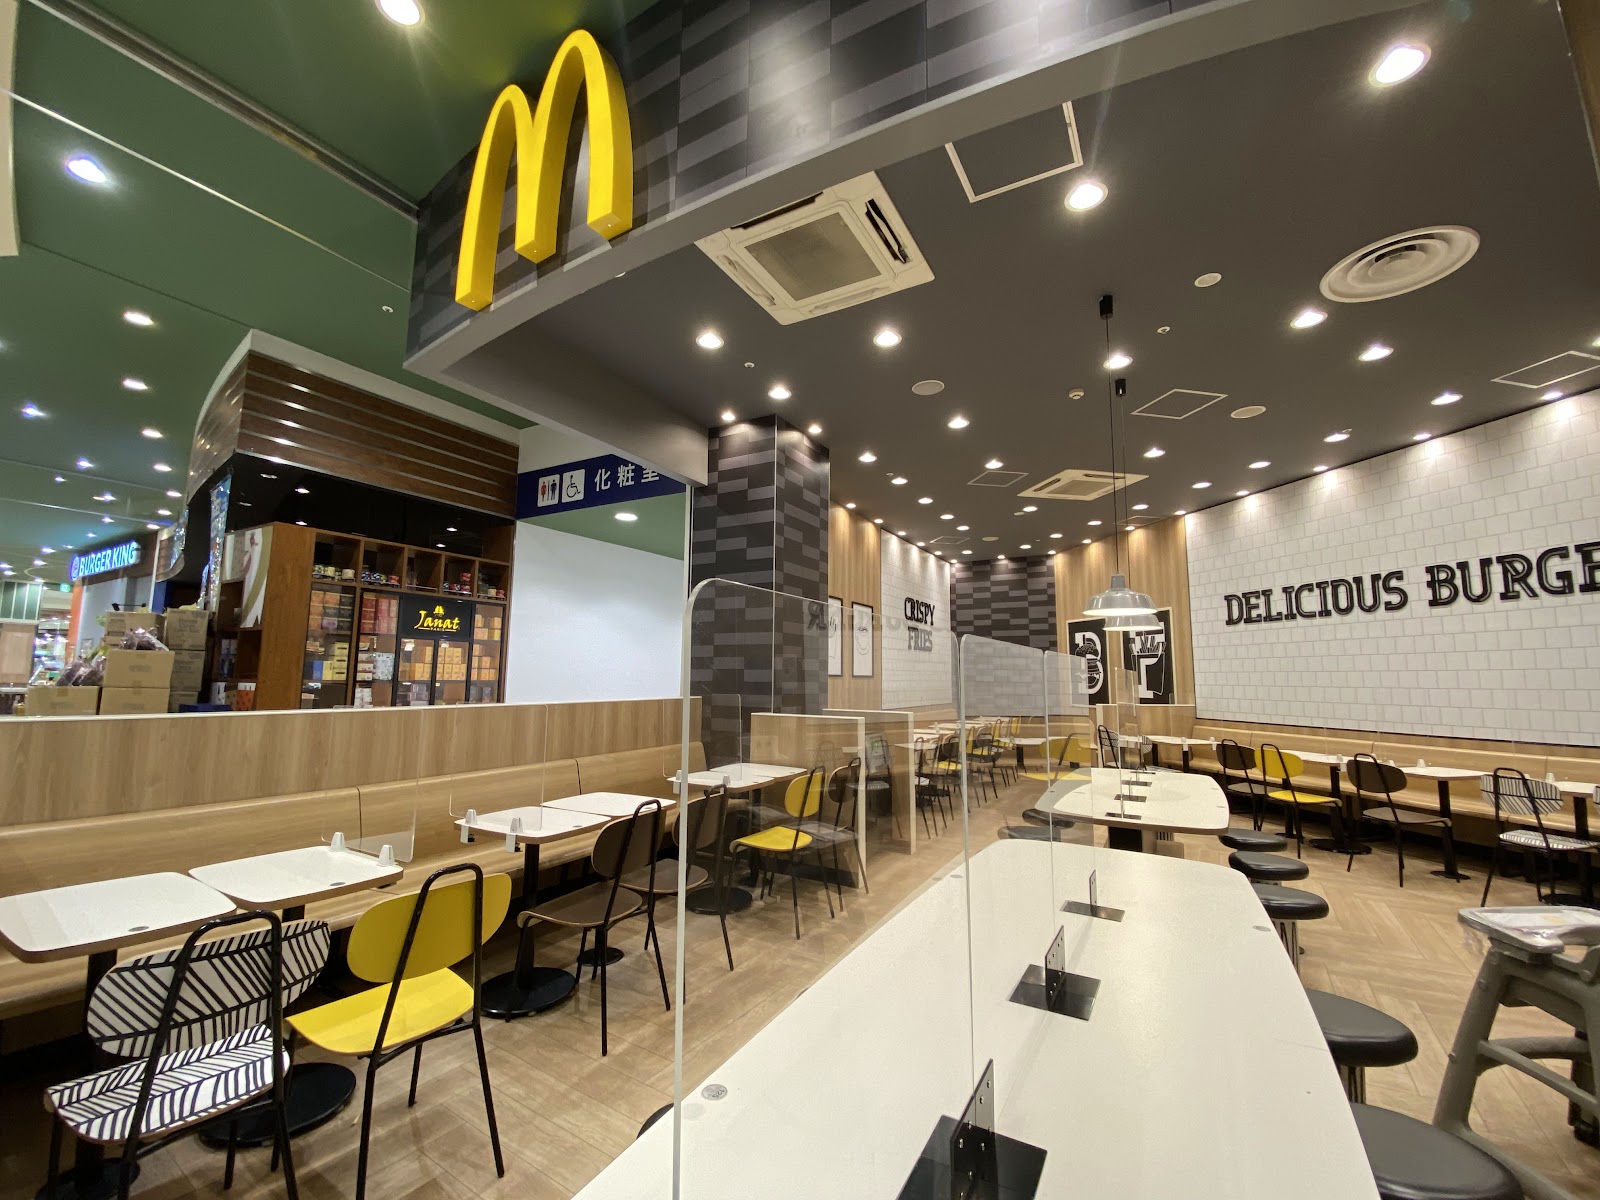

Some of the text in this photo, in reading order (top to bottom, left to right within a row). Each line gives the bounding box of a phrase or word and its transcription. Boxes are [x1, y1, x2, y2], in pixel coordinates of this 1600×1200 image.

[79, 548, 112, 577] BURGER
[112, 541, 138, 567] KING
[1224, 541, 1600, 625] DELICIOUS BURGE
[414, 610, 460, 630] Janat
[904, 597, 935, 626] CRISPY
[908, 626, 933, 652] FRIES
